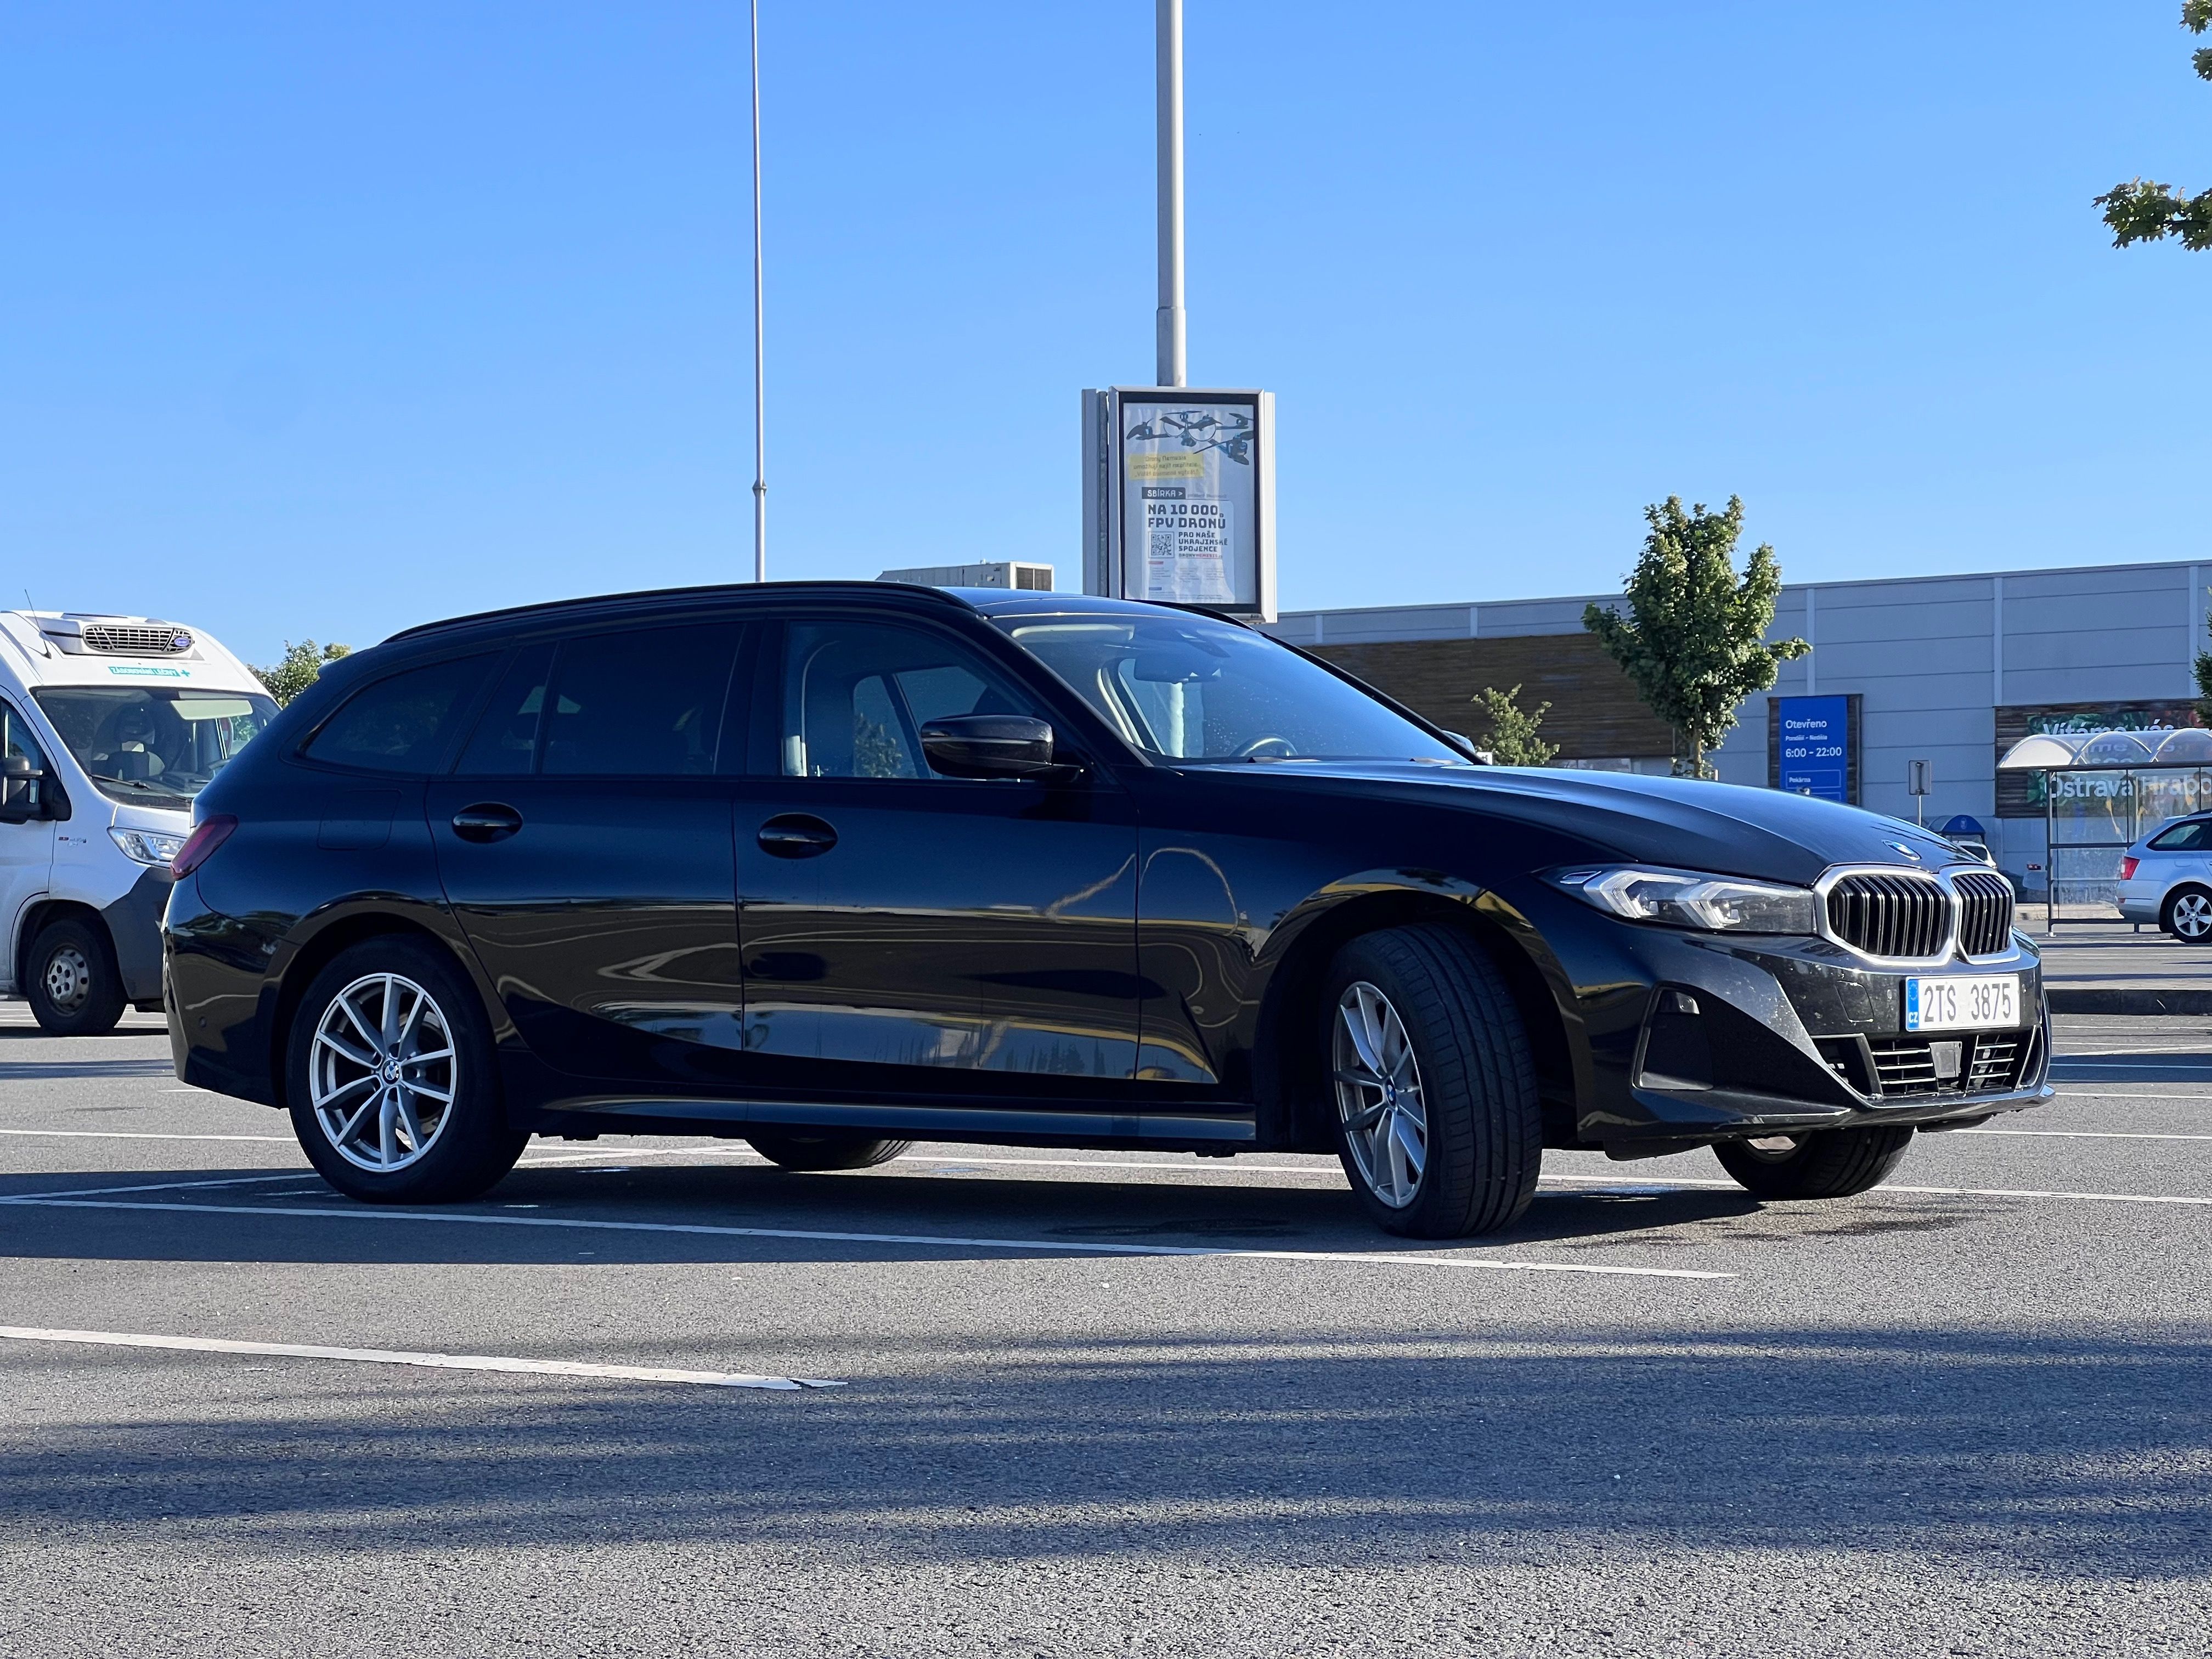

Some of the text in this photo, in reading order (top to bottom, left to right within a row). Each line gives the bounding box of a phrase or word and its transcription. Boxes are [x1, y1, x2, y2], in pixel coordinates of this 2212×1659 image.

[1147, 488, 1176, 497] SBÍRKA
[1148, 504, 1218, 515] NA 10 000
[1148, 513, 1226, 529] FPV DRONŮ
[1786, 719, 1827, 729] Otevřeno
[1786, 748, 1807, 757] 6:00
[1816, 747, 1842, 757] 22:00
[2044, 776, 2134, 798] Ostrava
[1925, 983, 2011, 1022] 2TS 3875
[1909, 1011, 1918, 1023] CZ
